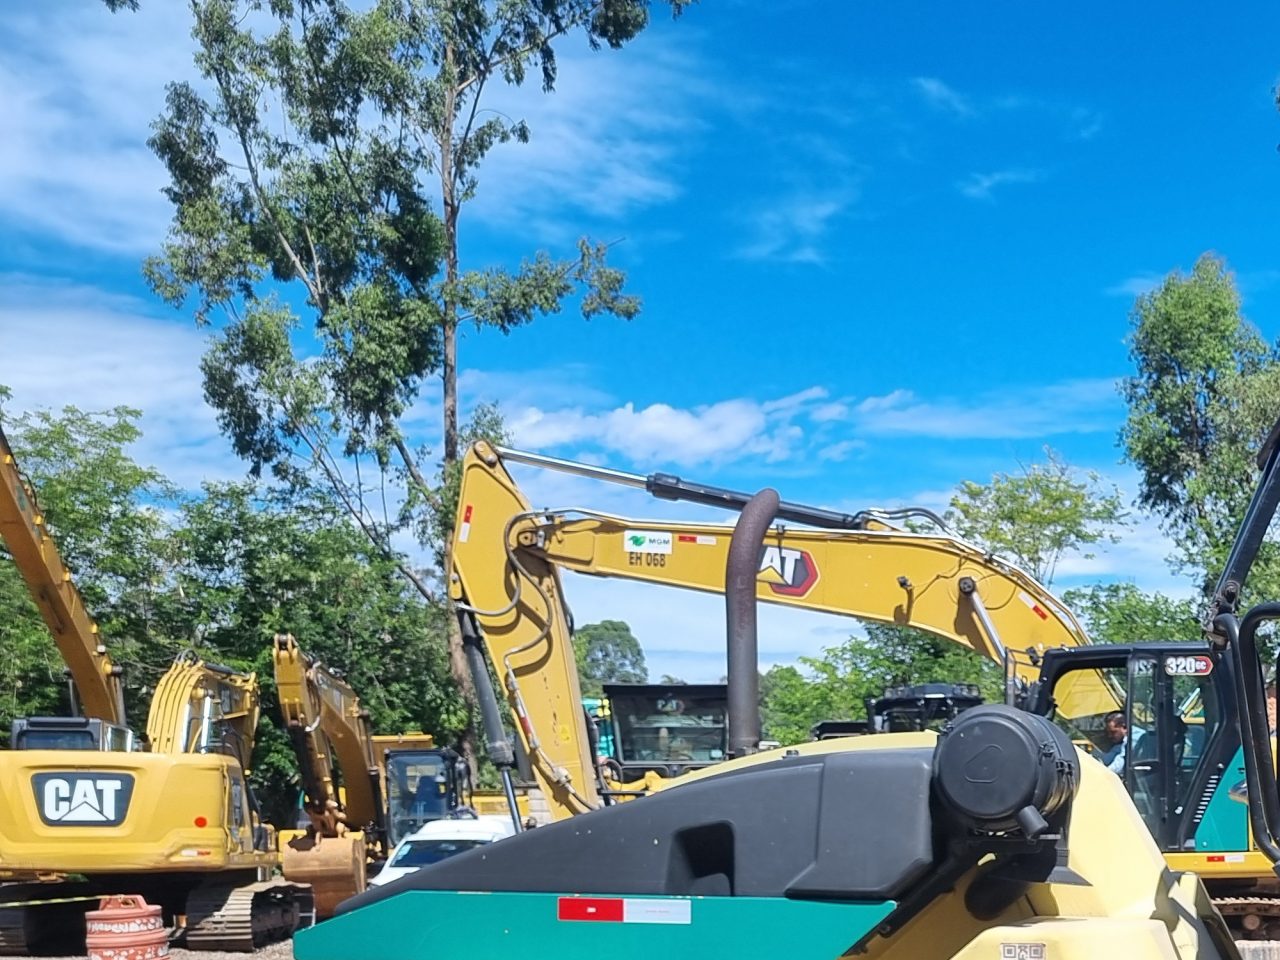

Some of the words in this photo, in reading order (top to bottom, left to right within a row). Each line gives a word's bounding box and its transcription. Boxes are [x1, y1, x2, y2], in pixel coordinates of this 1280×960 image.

[629, 552, 642, 567] EH
[646, 552, 666, 568] 068
[760, 546, 802, 586] AT
[1166, 656, 1196, 674] 320
[44, 777, 122, 821] CAT
